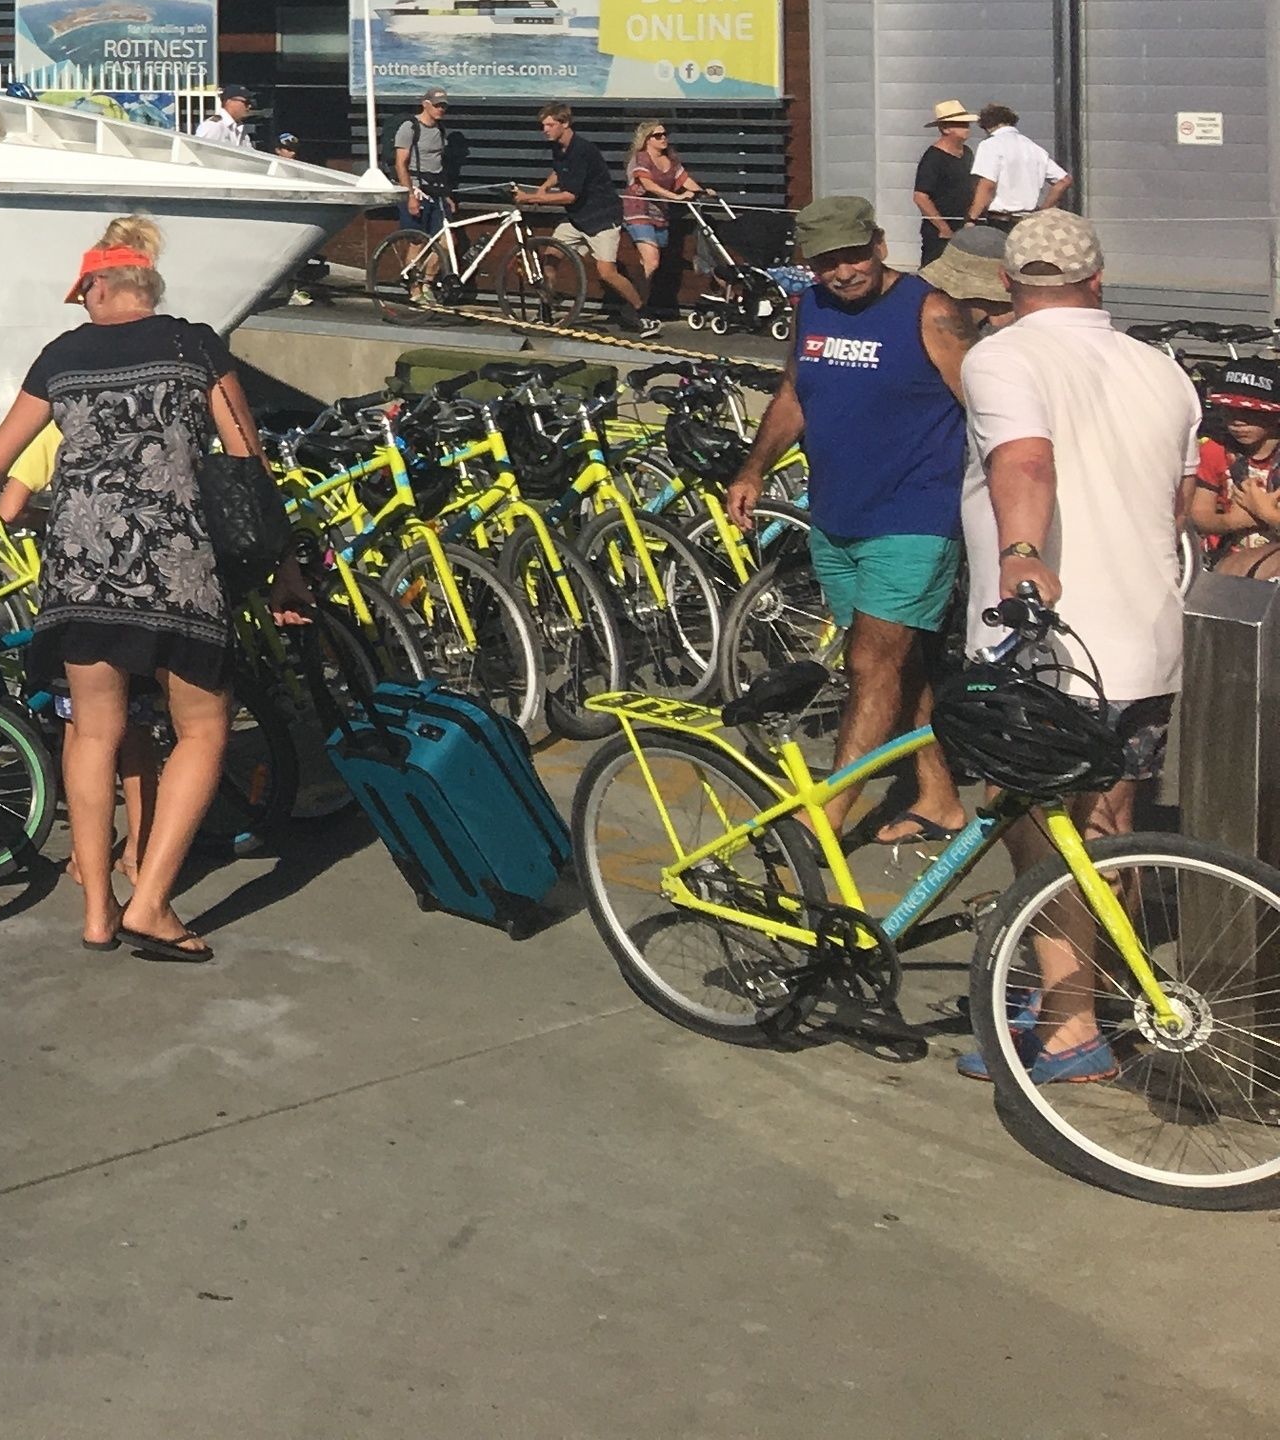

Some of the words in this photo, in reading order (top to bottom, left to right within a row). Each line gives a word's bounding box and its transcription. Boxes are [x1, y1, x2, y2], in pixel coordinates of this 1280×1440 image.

[625, 12, 754, 42] ONLINE
[103, 39, 208, 58] ROTTNEST
[104, 60, 141, 75] FAST
[144, 60, 208, 76] FERRIES
[372, 61, 578, 77] rottnestfastferries.com.au
[822, 336, 880, 363] DIESEL
[881, 881, 930, 937] ROTTNEST
[927, 857, 954, 887] FAST
